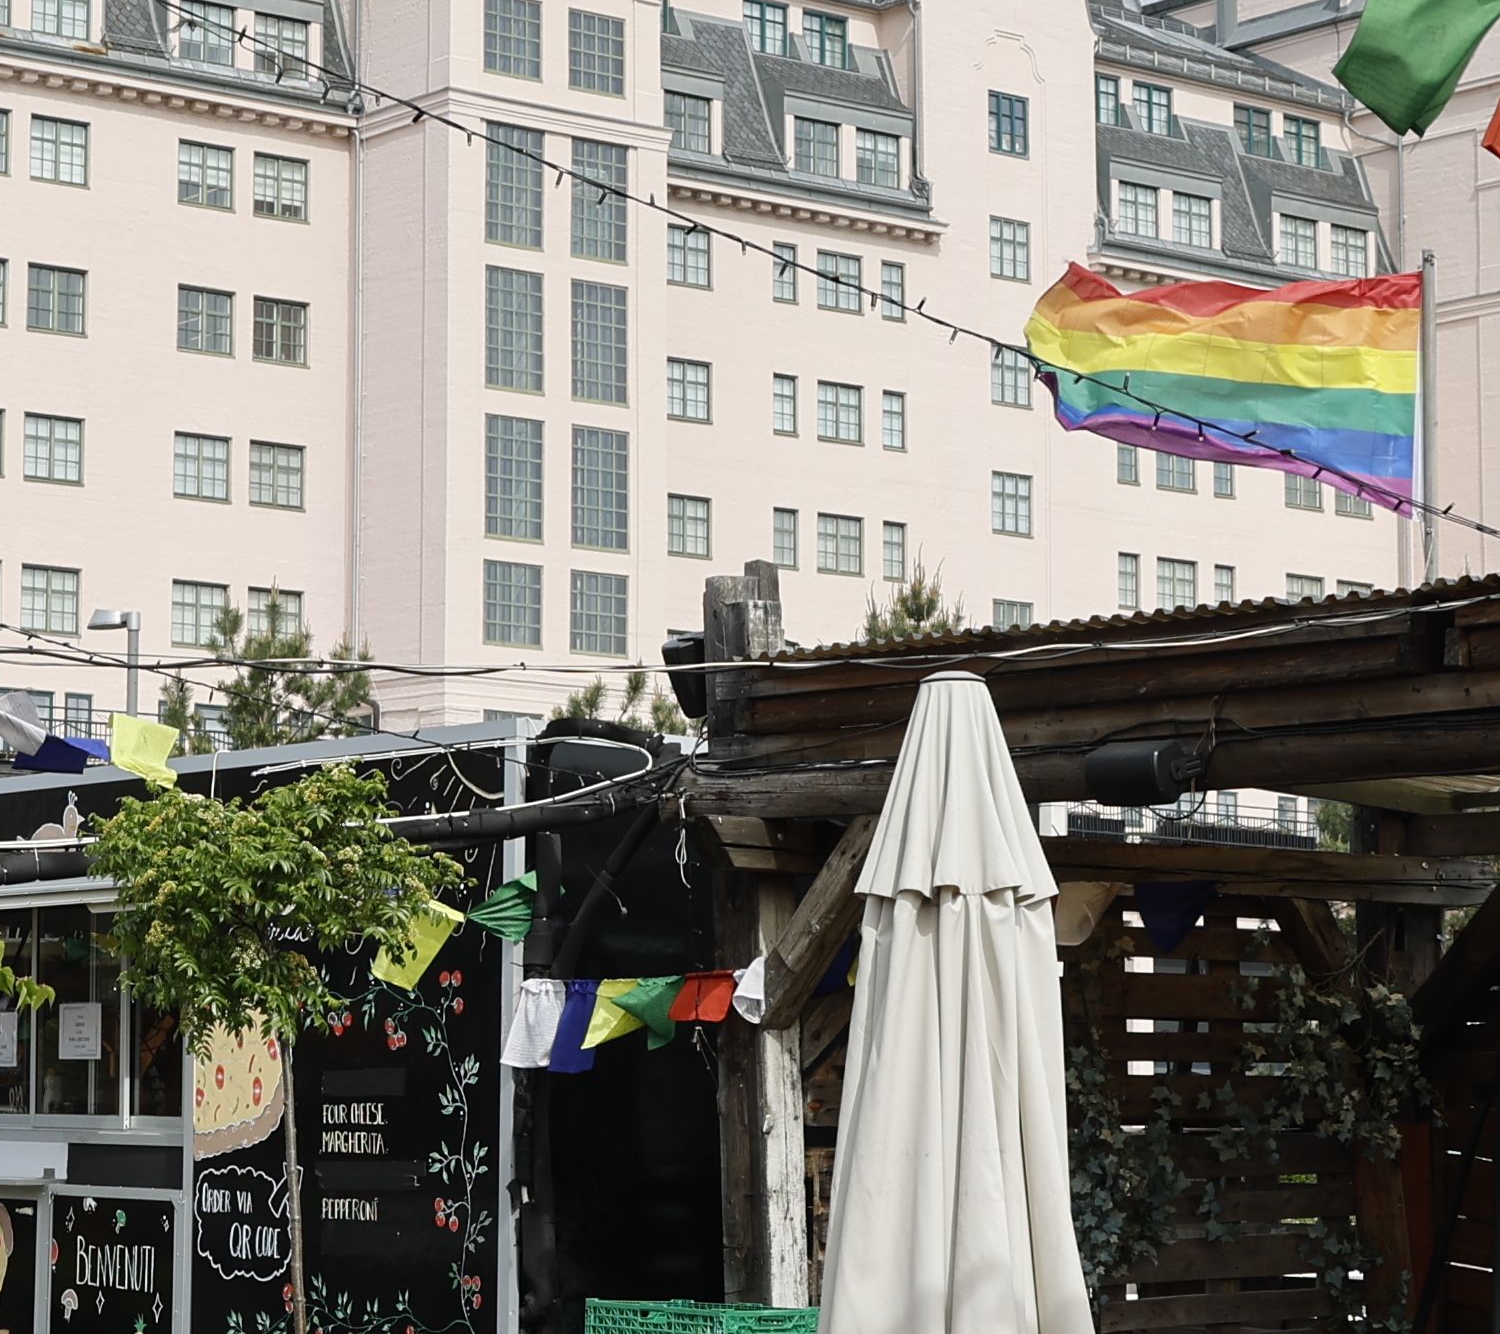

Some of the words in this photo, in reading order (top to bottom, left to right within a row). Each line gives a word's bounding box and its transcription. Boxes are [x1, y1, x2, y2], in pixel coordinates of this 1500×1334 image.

[322, 1103, 349, 1125] FOUR
[321, 1130, 386, 1155] MARGHERITA
[202, 1182, 231, 1213] ORDER
[236, 1190, 253, 1214] VIA
[321, 1196, 379, 1222] PEPPERONI
[229, 1222, 252, 1260] QR
[255, 1225, 281, 1259] CODE
[75, 1234, 156, 1294] BENVENUTI
